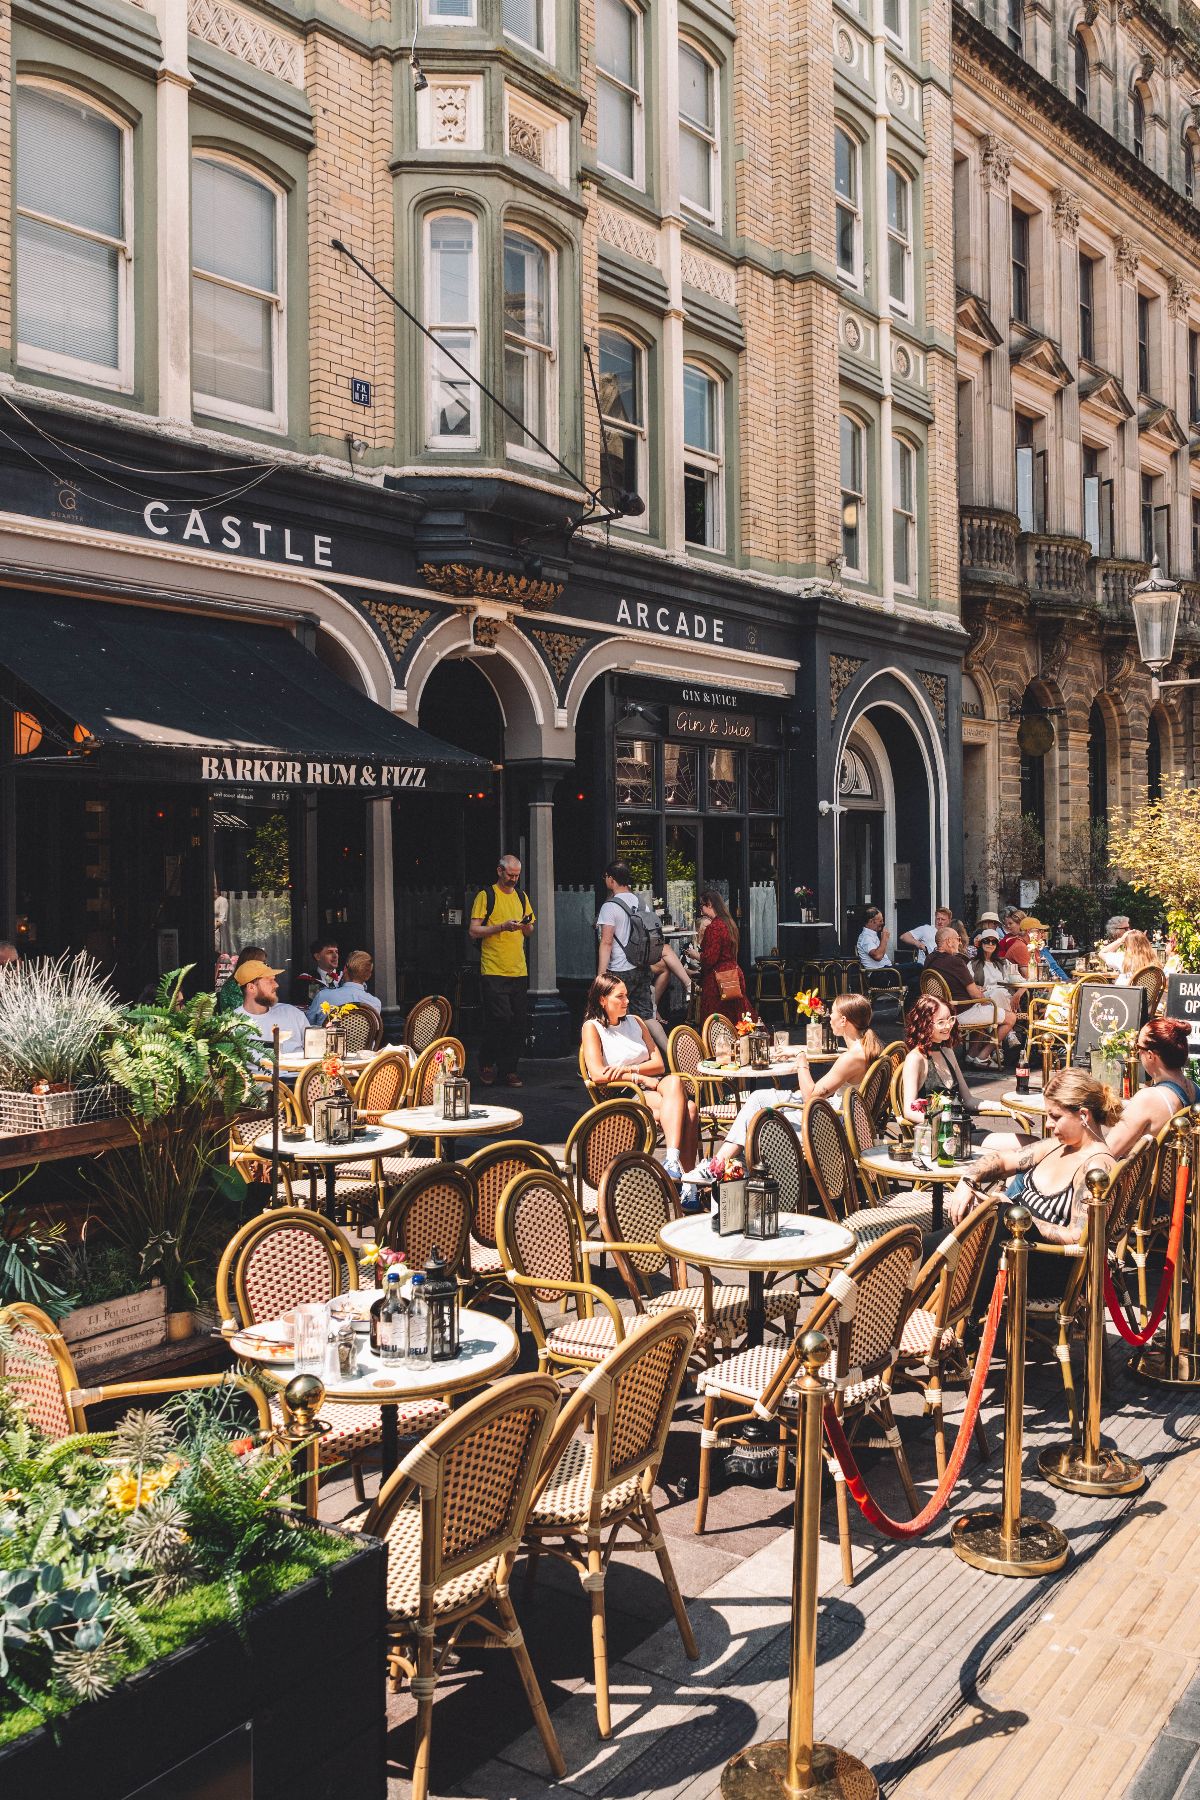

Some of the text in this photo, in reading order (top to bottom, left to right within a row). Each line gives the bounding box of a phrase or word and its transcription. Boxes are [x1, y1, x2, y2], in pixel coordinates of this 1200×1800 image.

[143, 501, 333, 568] CASTLE
[616, 599, 724, 643] ARCADE
[682, 690, 737, 707] GIN & JUICE
[676, 711, 752, 738] Gin & Juice
[201, 756, 426, 788] BARKER RUM & FIZZ
[104, 1327, 155, 1348] MERCHANTS
